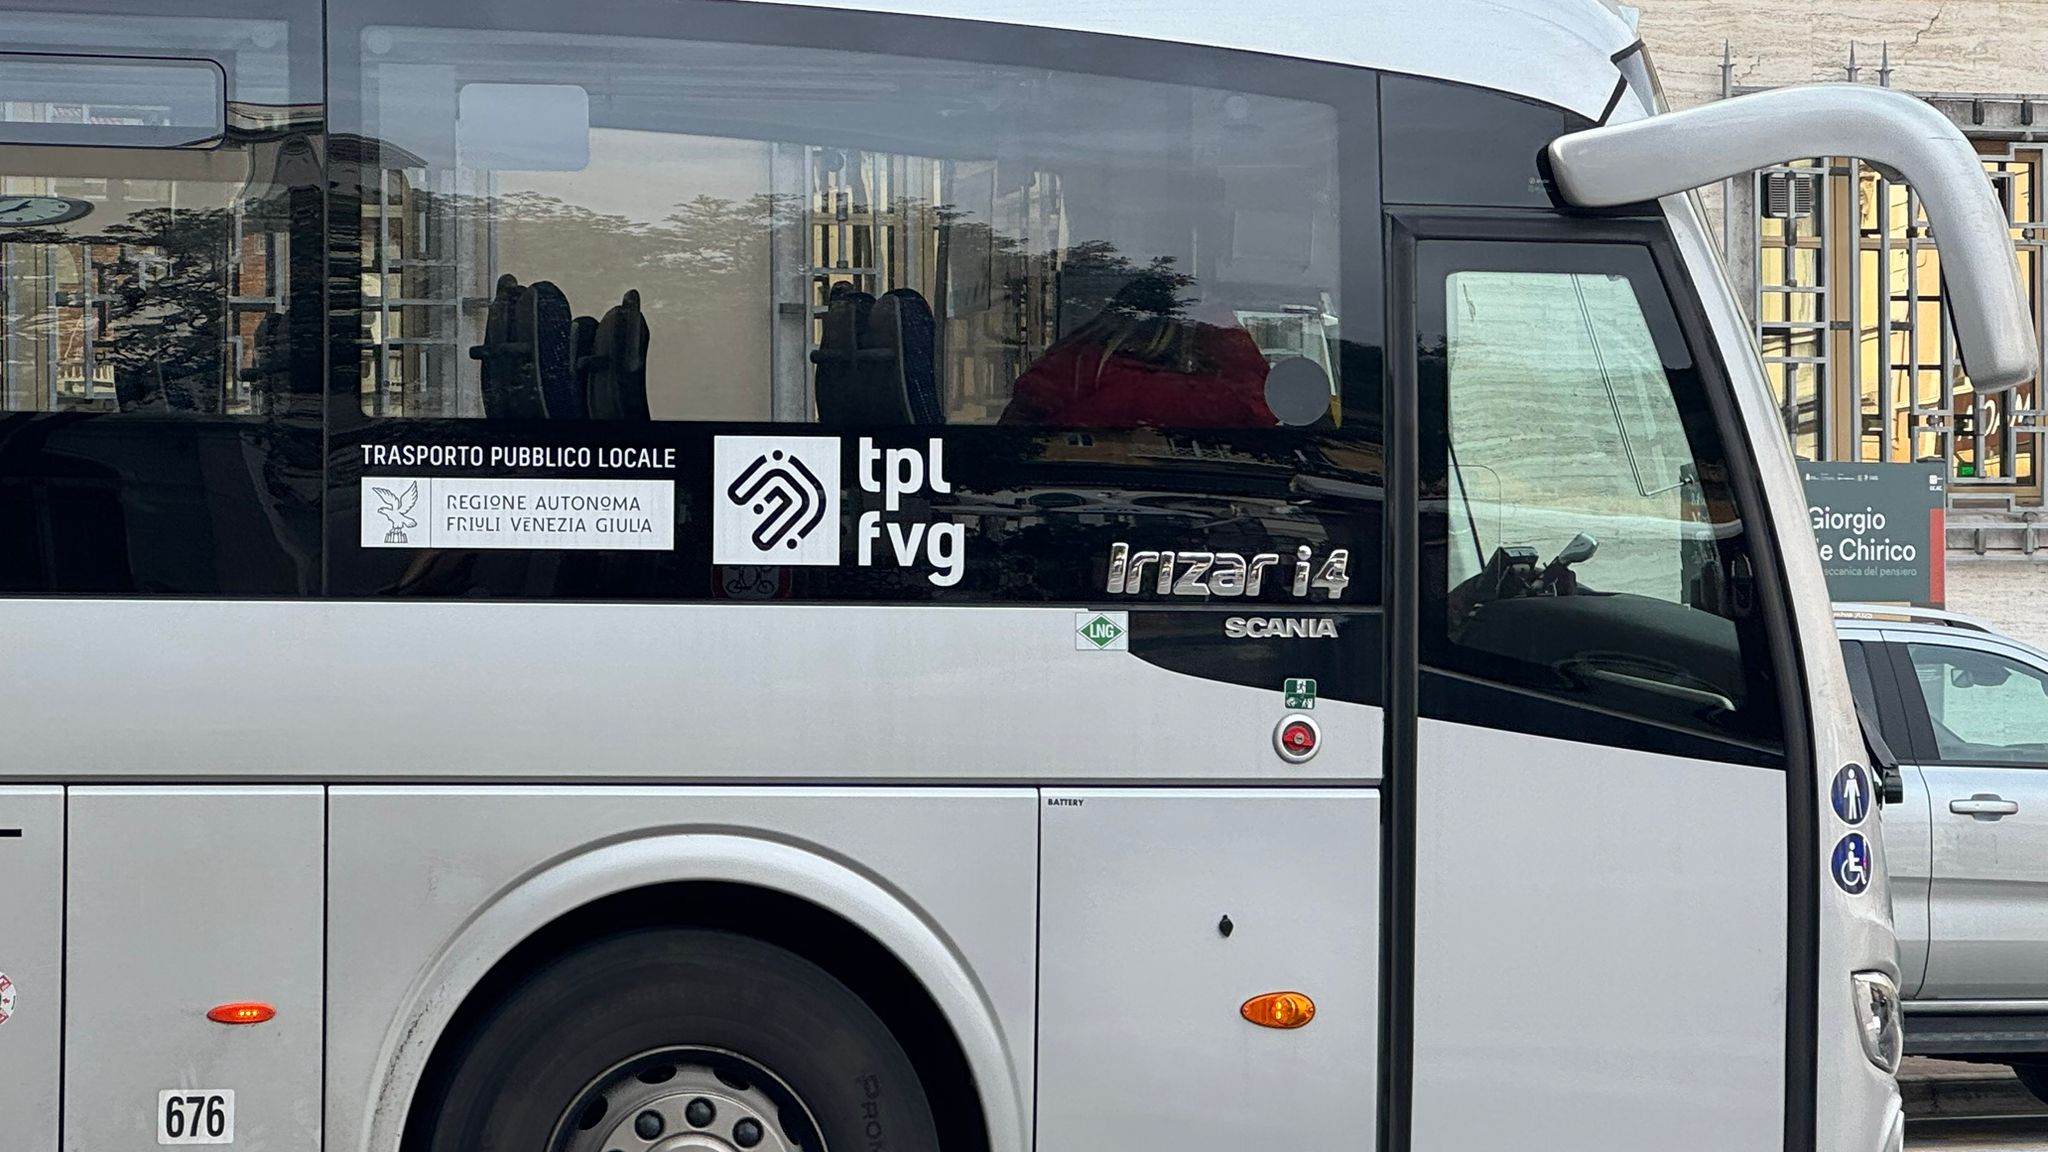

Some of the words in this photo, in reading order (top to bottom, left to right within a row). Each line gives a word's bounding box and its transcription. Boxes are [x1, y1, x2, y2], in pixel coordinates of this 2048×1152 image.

[361, 444, 483, 466] TRASPORTO
[491, 447, 590, 467] PUBBLICO
[598, 448, 676, 468] LOCALE
[858, 437, 951, 511] tpl
[447, 495, 526, 511] REGIONE
[535, 496, 641, 512] AUTONOMA
[447, 517, 500, 532] FRIULI
[511, 517, 587, 533] VENEZIA
[595, 518, 652, 533] GIULIA
[1809, 506, 1886, 535] Giorgio
[858, 511, 965, 587] fvg
[1816, 538, 1833, 561] e
[1839, 538, 1917, 562] Chirico
[1106, 542, 1279, 596] Irizar
[1292, 545, 1350, 599] i4
[1824, 566, 1862, 576] eccanica
[1864, 566, 1878, 576] del
[1880, 567, 1917, 577] pensiero
[1089, 622, 1114, 639] LNG
[1225, 617, 1339, 638] SCANIA
[1047, 798, 1084, 806] BATTERY
[166, 1095, 225, 1138] 676
